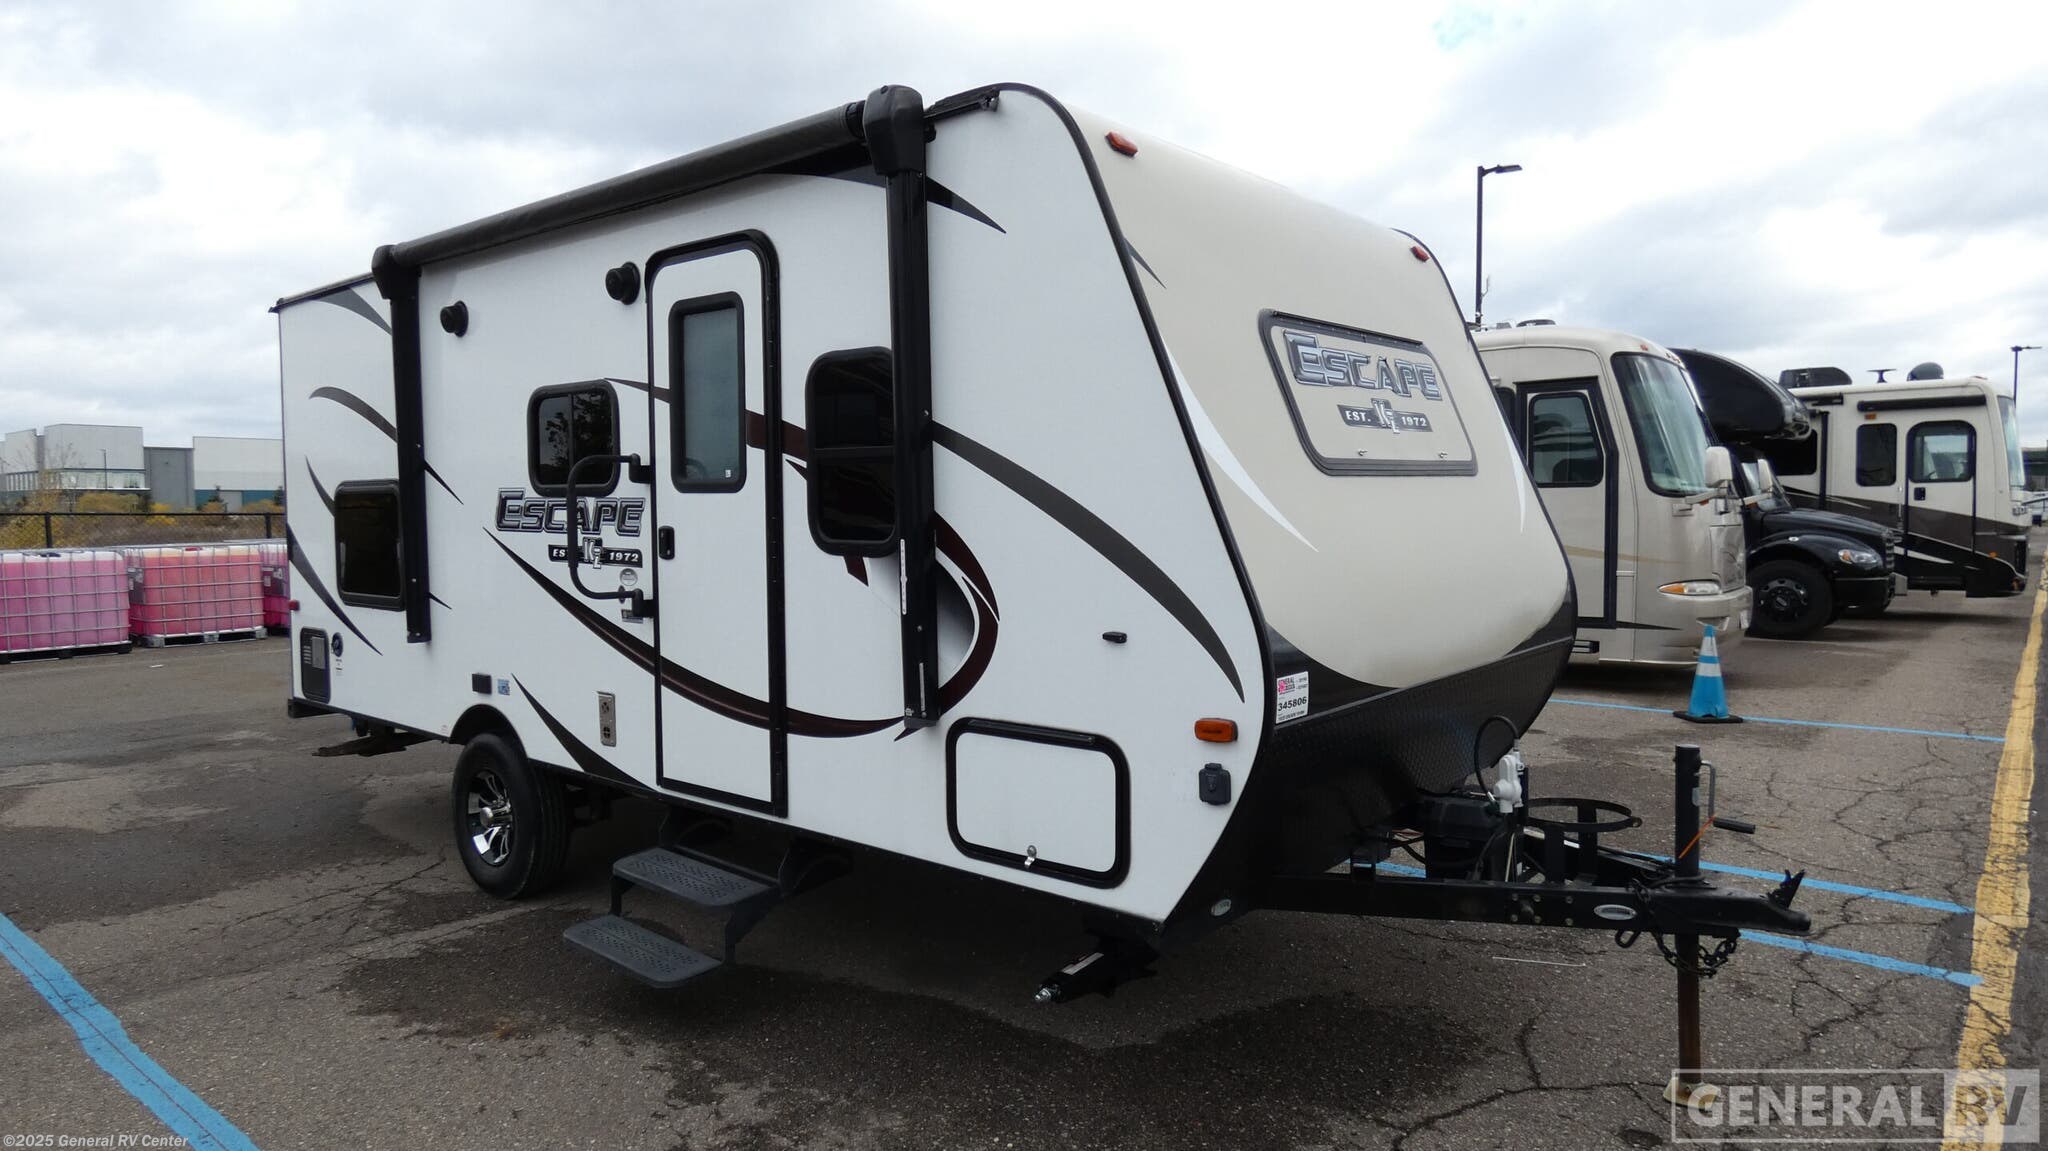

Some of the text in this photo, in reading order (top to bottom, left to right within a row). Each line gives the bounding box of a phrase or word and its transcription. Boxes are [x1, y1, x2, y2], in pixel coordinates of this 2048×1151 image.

[1283, 329, 1442, 400] ESCAPE
[1345, 410, 1372, 423] EST.
[1401, 416, 1427, 427] 1972
[496, 488, 645, 537] ESCAPE
[609, 552, 639, 562] 1972
[1278, 696, 1307, 711] 345806
